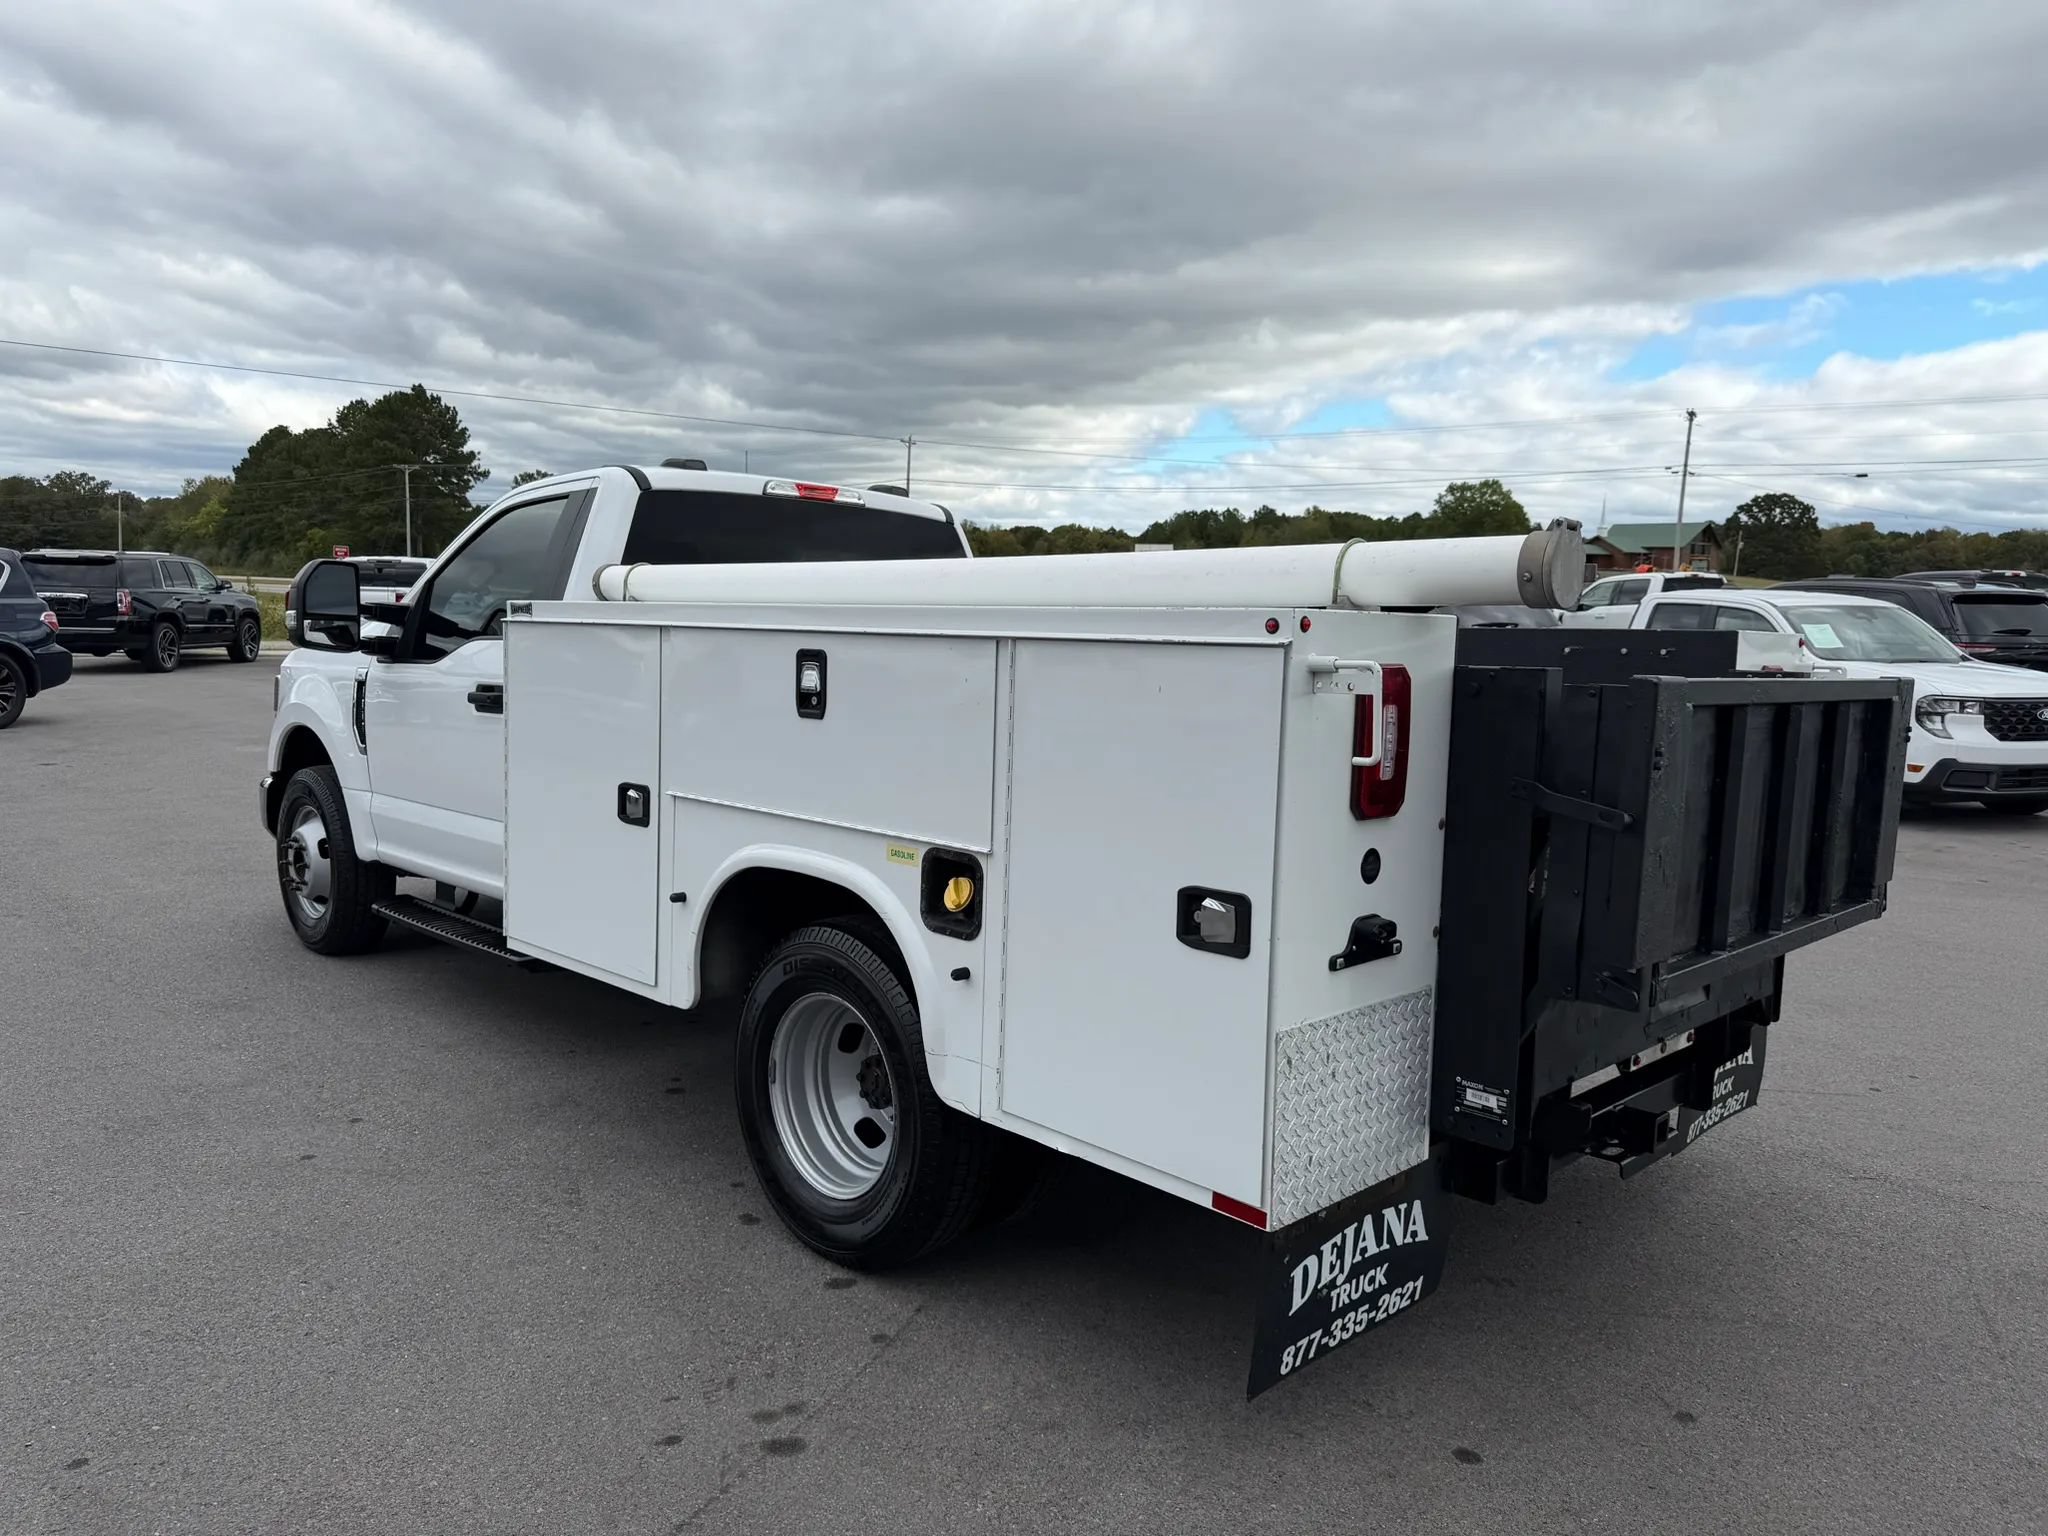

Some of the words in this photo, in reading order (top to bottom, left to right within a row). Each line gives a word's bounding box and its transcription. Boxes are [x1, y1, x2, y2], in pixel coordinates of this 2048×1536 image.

[890, 848, 915, 861] GASOLINE
[1687, 1089, 1750, 1143] 877-335-2621
[1288, 1199, 1429, 1317] DEJANA
[1330, 1262, 1389, 1312] TRUCK
[1279, 1275, 1424, 1376] 877-335-2621
